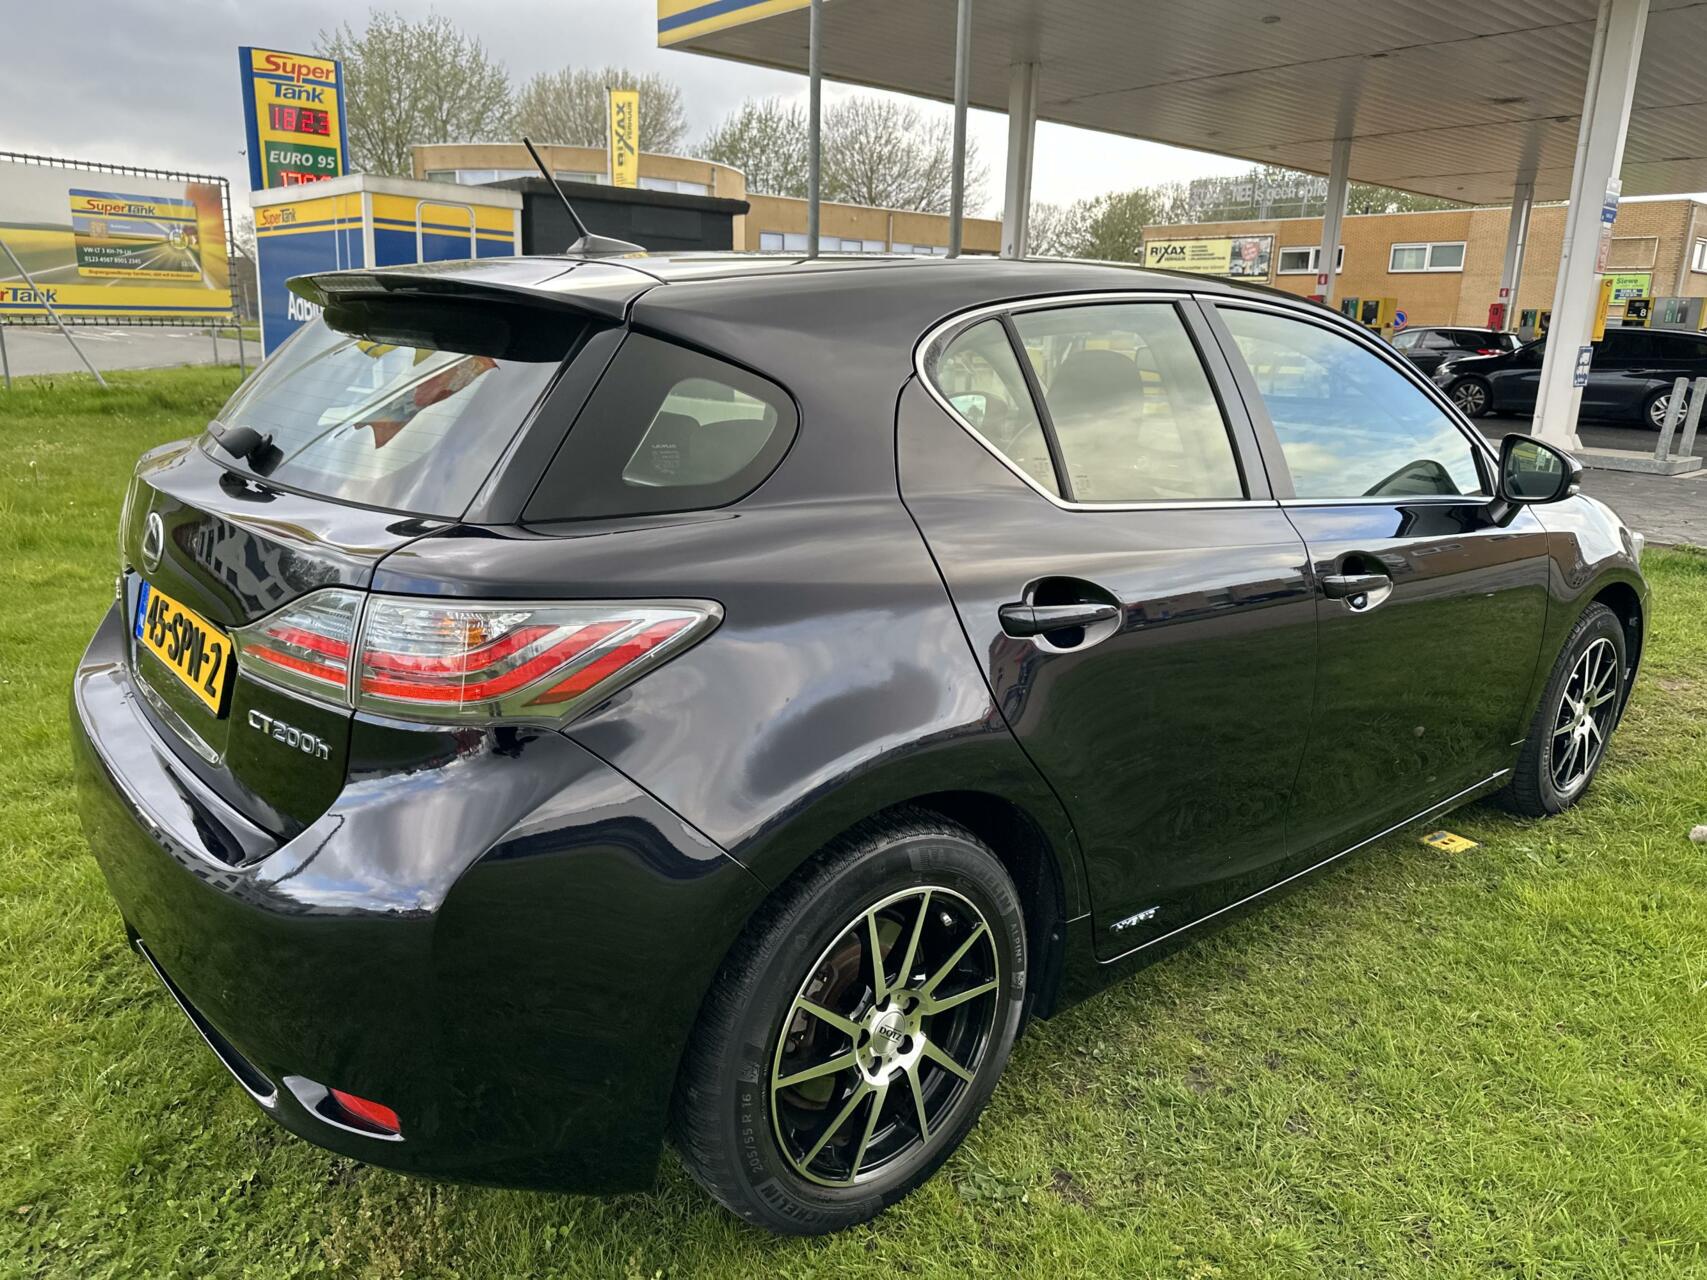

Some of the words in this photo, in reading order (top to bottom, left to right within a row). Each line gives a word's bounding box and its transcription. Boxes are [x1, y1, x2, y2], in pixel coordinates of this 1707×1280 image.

[254, 54, 334, 83] Super
[268, 81, 325, 104] Tank
[274, 107, 331, 135] 1823
[269, 150, 313, 167] EURO
[317, 156, 336, 169] 95
[280, 172, 333, 188] 17
[81, 199, 156, 217] SuperTank
[260, 208, 296, 227] SuperTank
[1639, 308, 1647, 317] 8
[147, 595, 222, 698] 45-SPN-2
[879, 1026, 902, 1041] DOTZ
[742, 1093, 753, 1109] 16
[742, 1113, 752, 1123] R
[742, 1128, 765, 1174] 205/55
